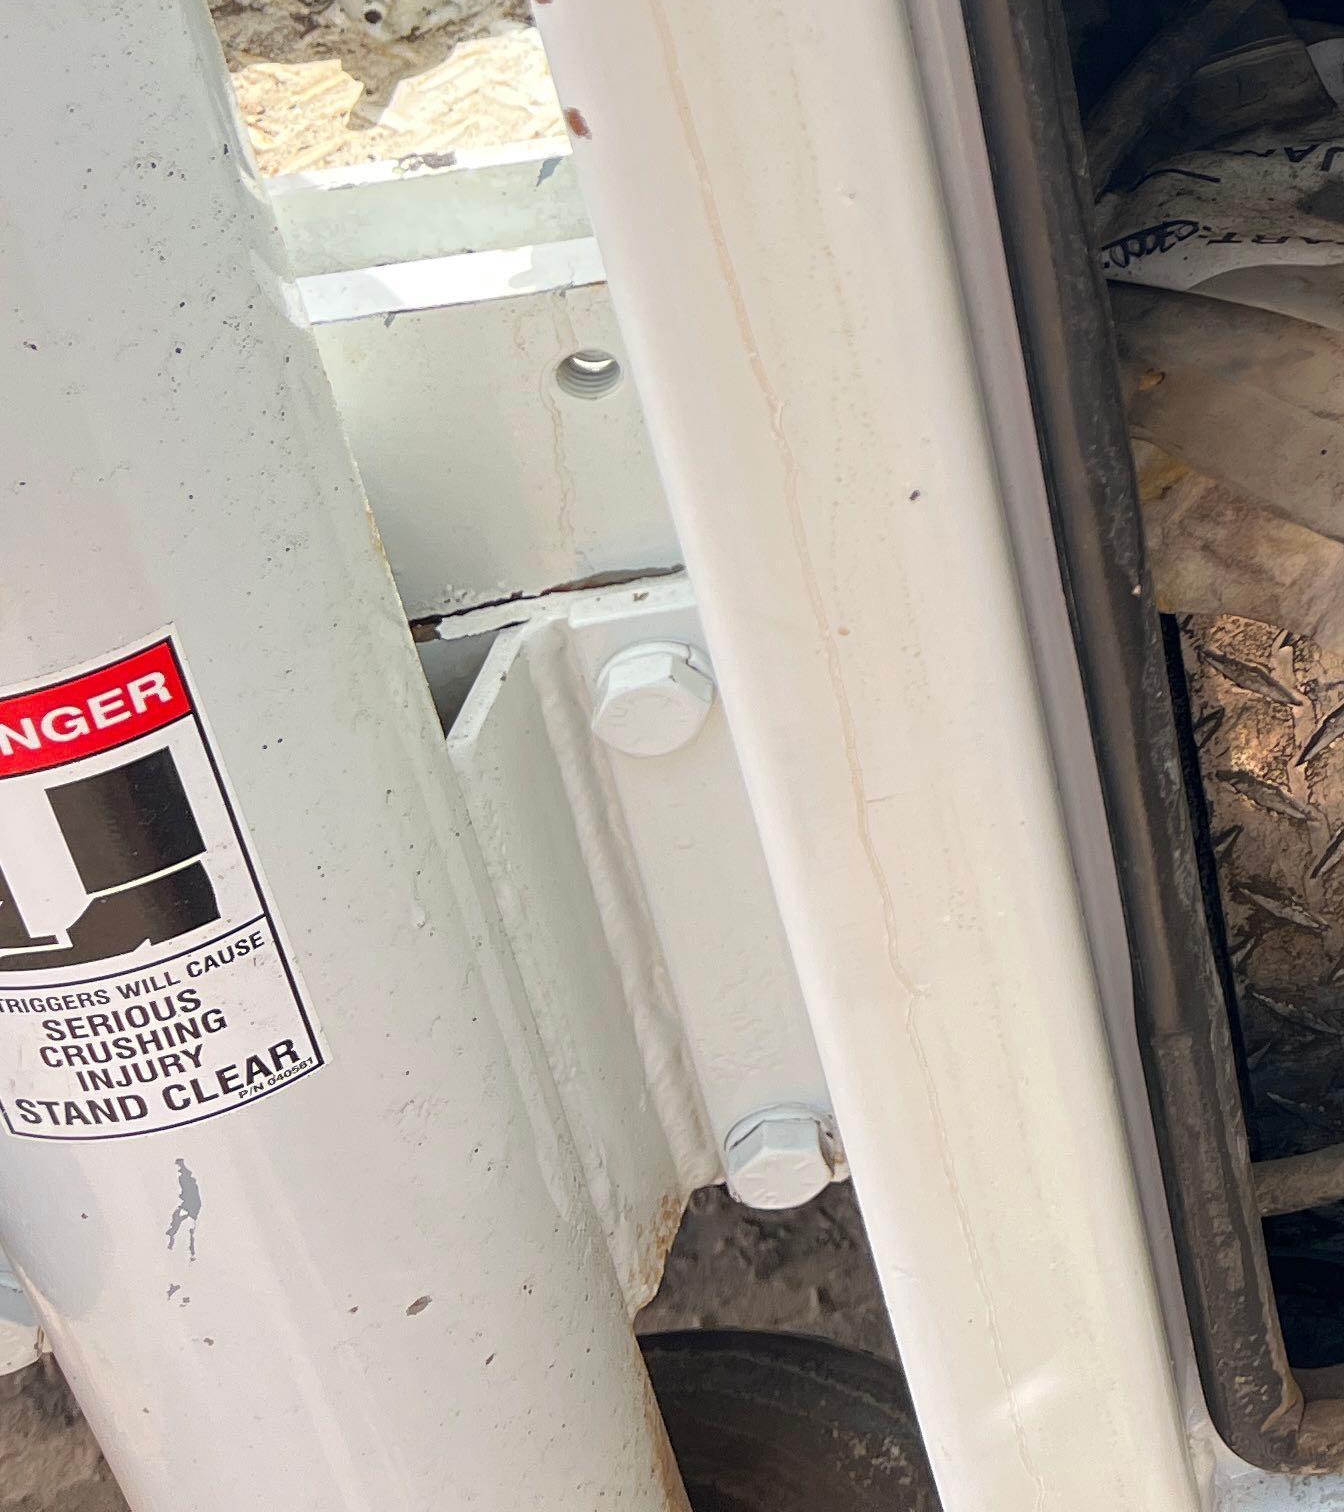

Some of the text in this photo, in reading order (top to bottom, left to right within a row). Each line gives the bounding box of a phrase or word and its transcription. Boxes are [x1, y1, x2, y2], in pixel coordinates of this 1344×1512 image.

[116, 971, 181, 1000] WILL
[186, 930, 265, 978] CAUSE
[40, 1008, 229, 1068] CRUSHING
[42, 988, 201, 1041] SERIOUS
[15, 1039, 301, 1126] STAND CLEAR
[75, 1043, 203, 1091] INJURY
[239, 1082, 264, 1099] P/N
